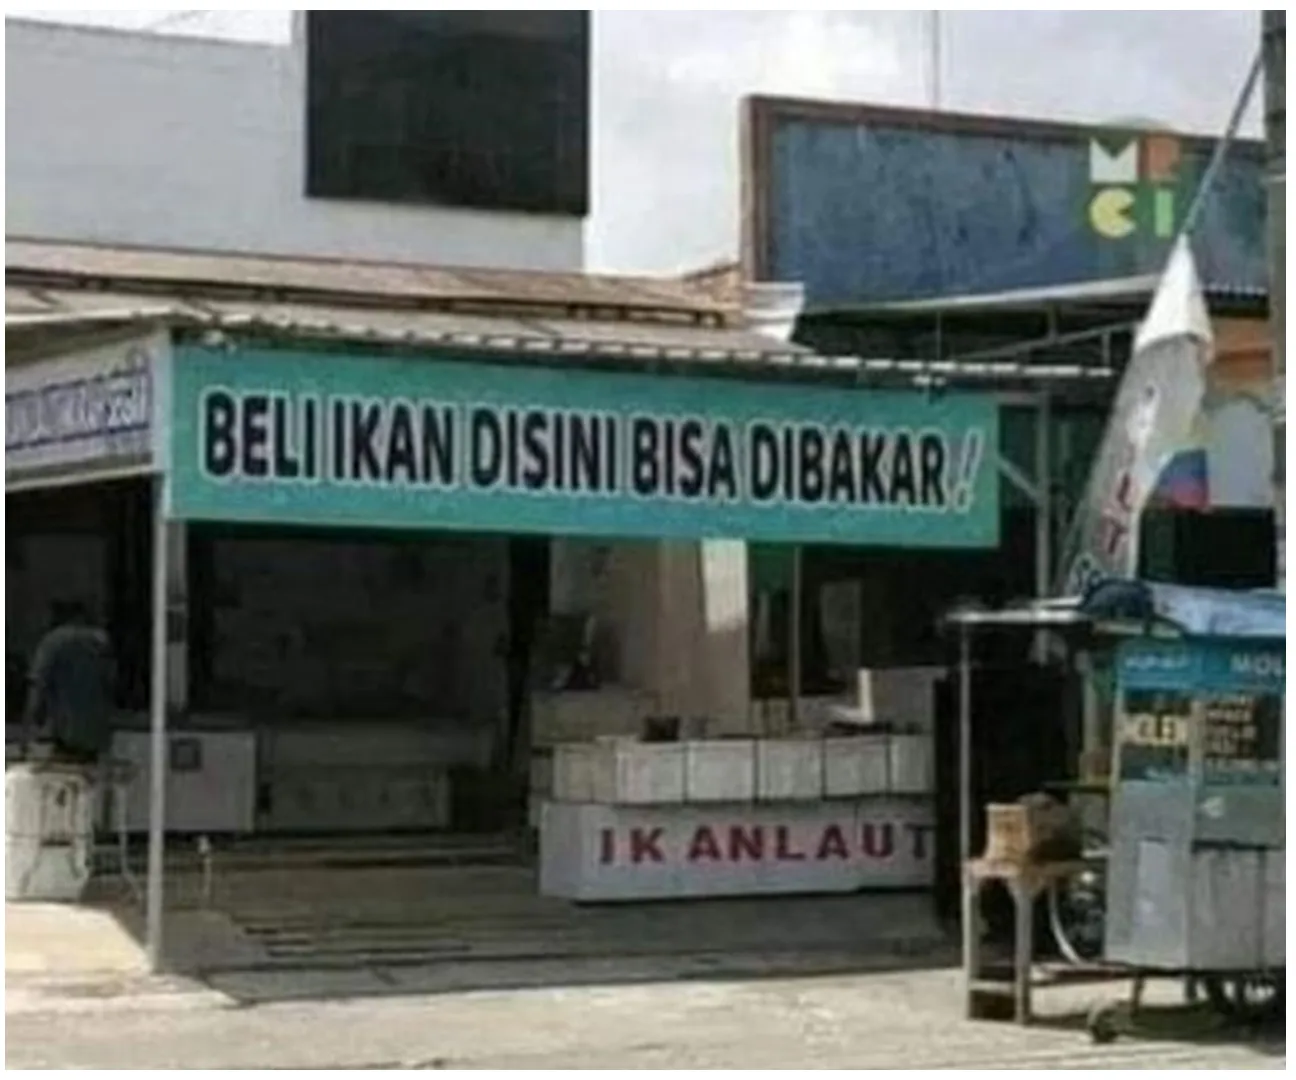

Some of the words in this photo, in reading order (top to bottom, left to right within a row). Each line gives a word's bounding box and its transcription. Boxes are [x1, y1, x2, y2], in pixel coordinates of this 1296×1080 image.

[202, 386, 319, 481] BELI
[330, 396, 456, 488] IKAN
[468, 404, 618, 496] DISINI
[630, 412, 738, 500] BISA
